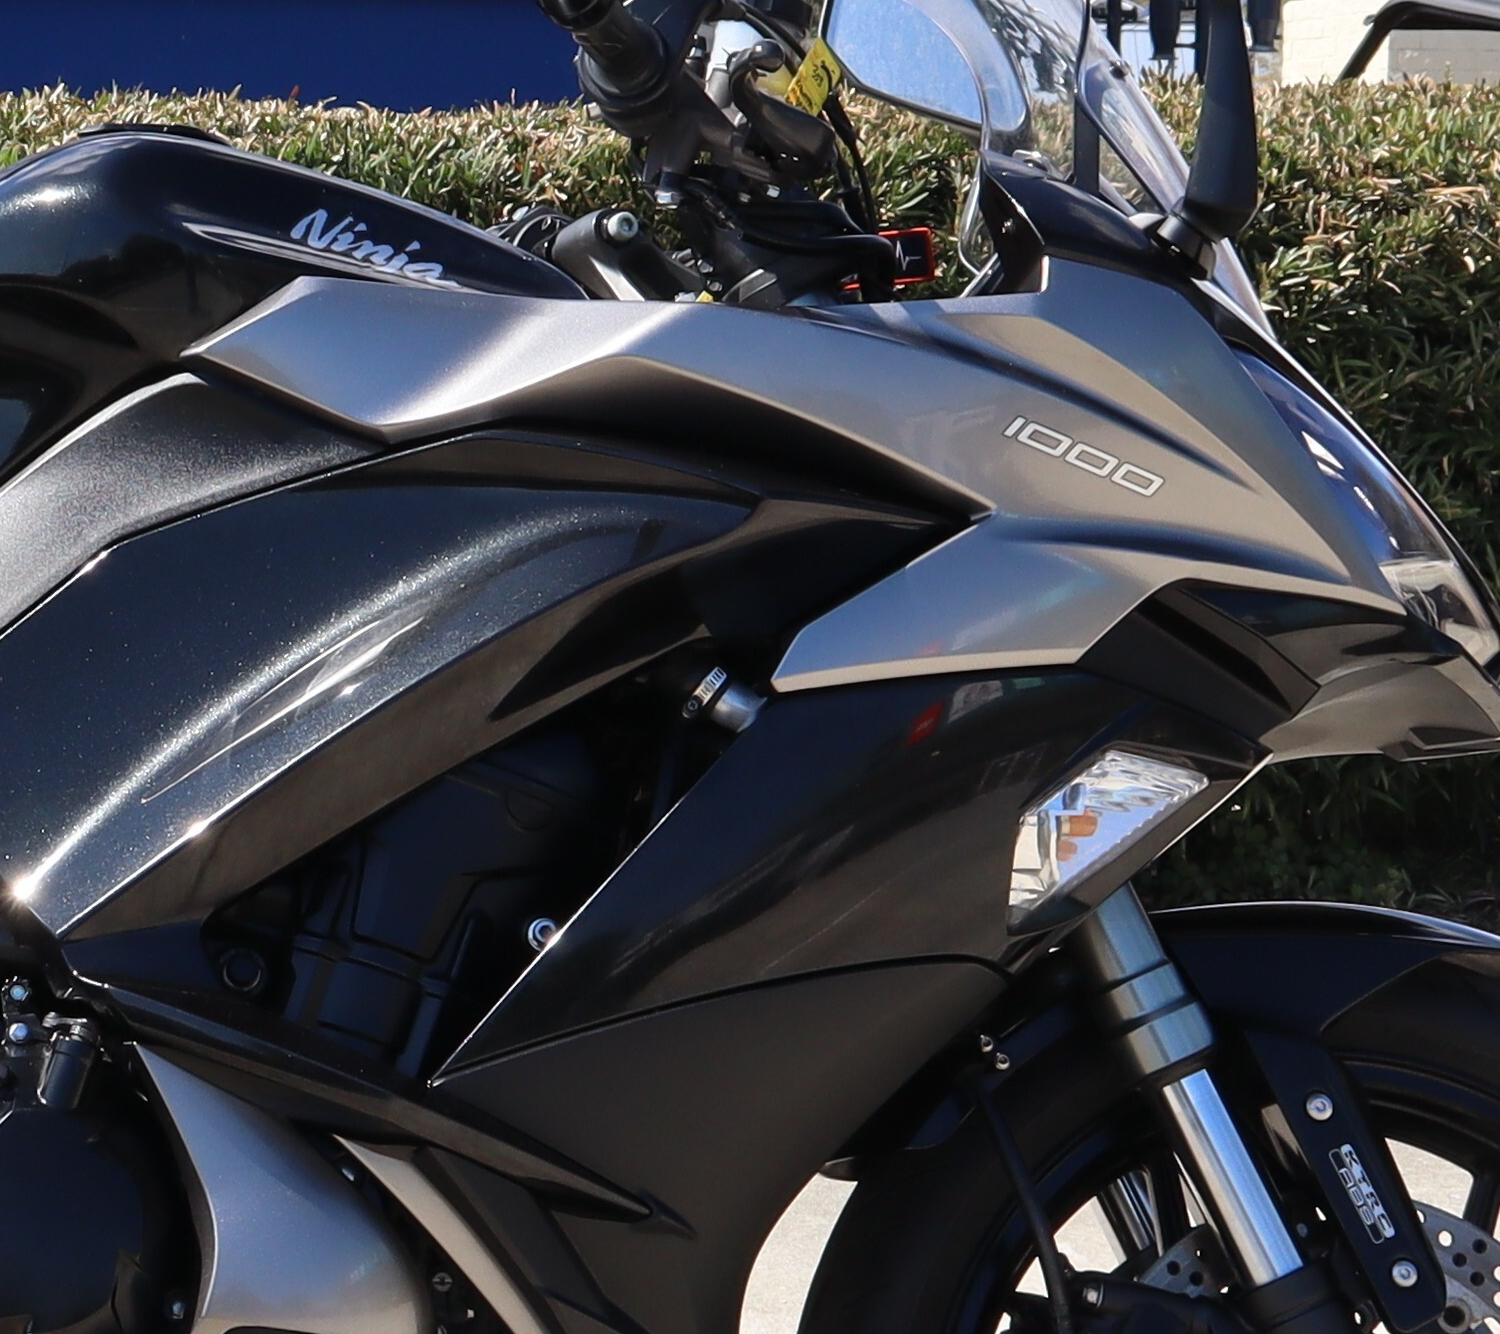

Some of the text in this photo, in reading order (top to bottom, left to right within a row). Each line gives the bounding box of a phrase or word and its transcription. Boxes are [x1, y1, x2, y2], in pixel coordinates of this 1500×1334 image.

[290, 208, 461, 287] Ninja
[1003, 415, 1165, 498] 1000
[1338, 1167, 1375, 1226] ABS
[1344, 1149, 1392, 1231] KTRC
